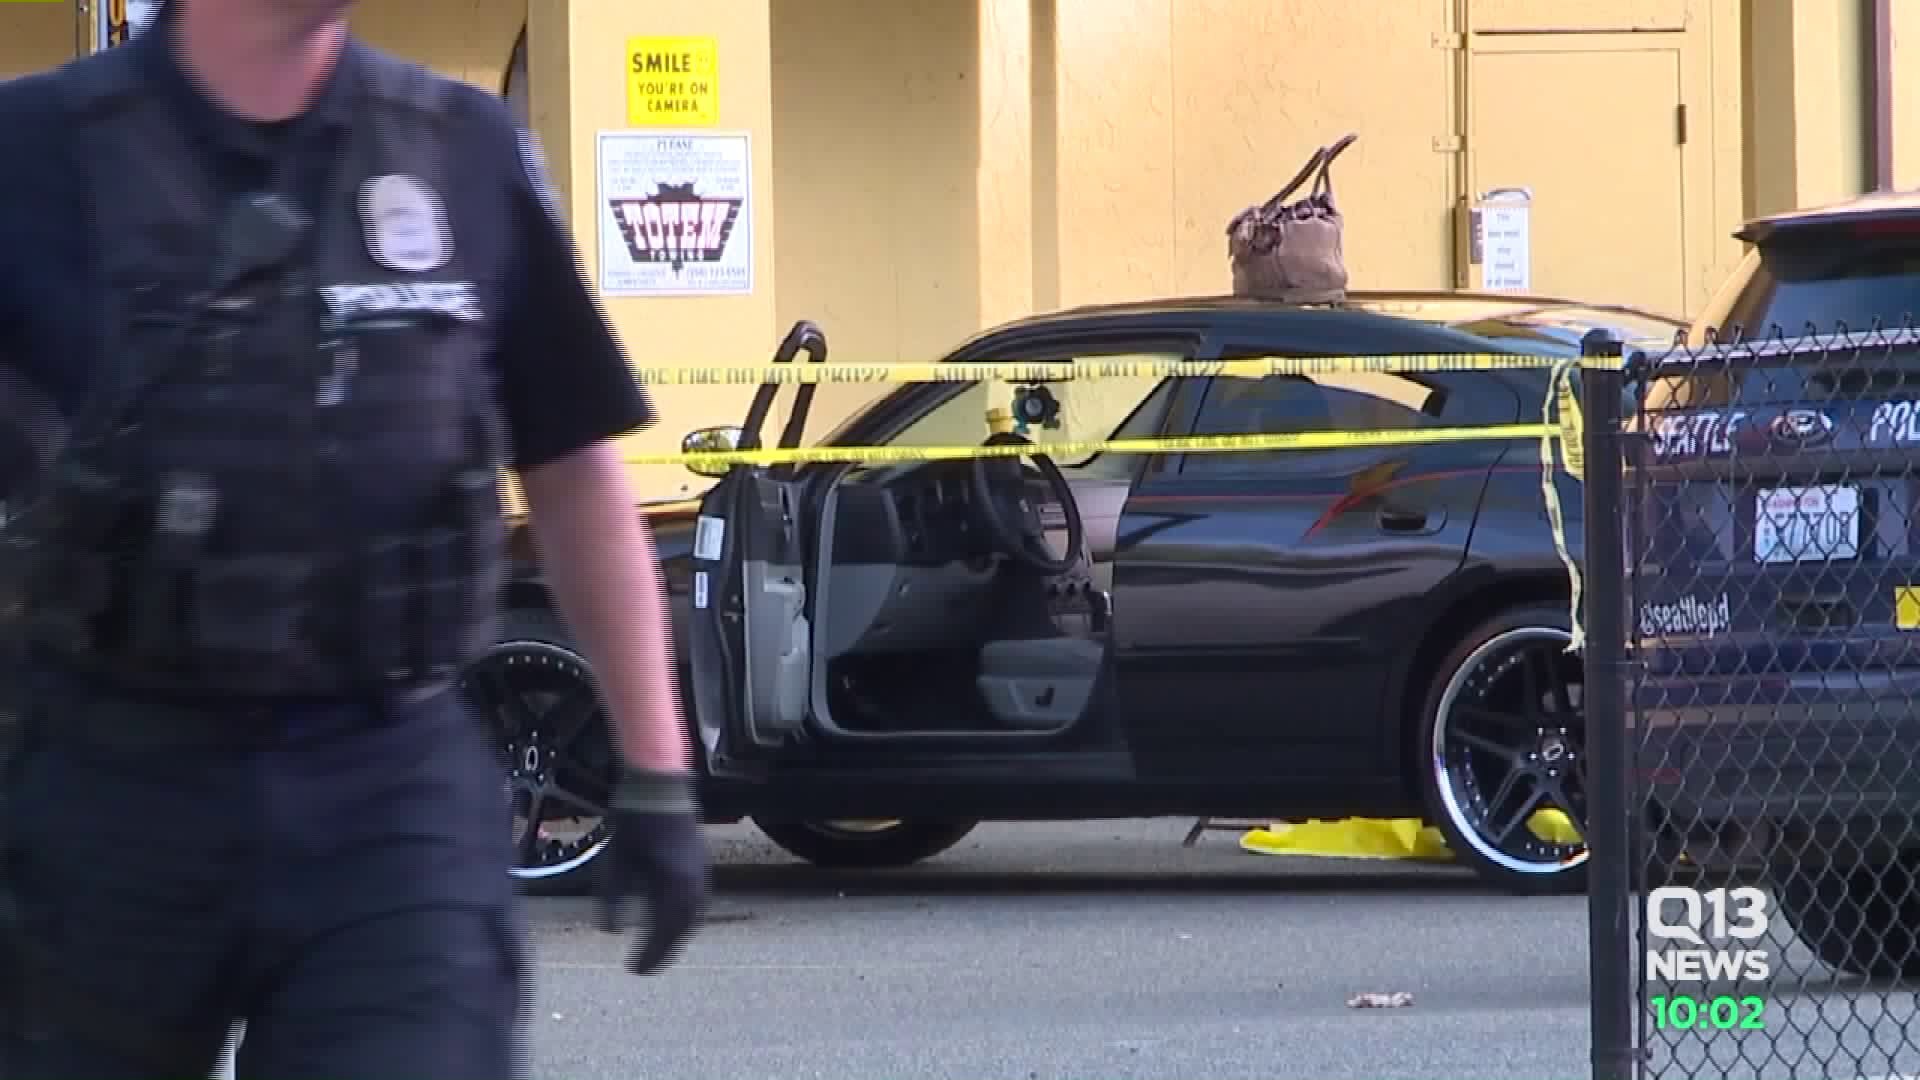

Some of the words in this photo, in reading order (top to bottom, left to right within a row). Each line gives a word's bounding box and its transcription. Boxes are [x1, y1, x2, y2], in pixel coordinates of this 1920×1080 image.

[632, 53, 691, 73] SMILE
[638, 82, 684, 95] YOU'RE
[690, 82, 708, 95] ON
[647, 100, 698, 112] CAMERA
[620, 202, 731, 250] TOTEM
[1653, 412, 1746, 455] SEATTLE
